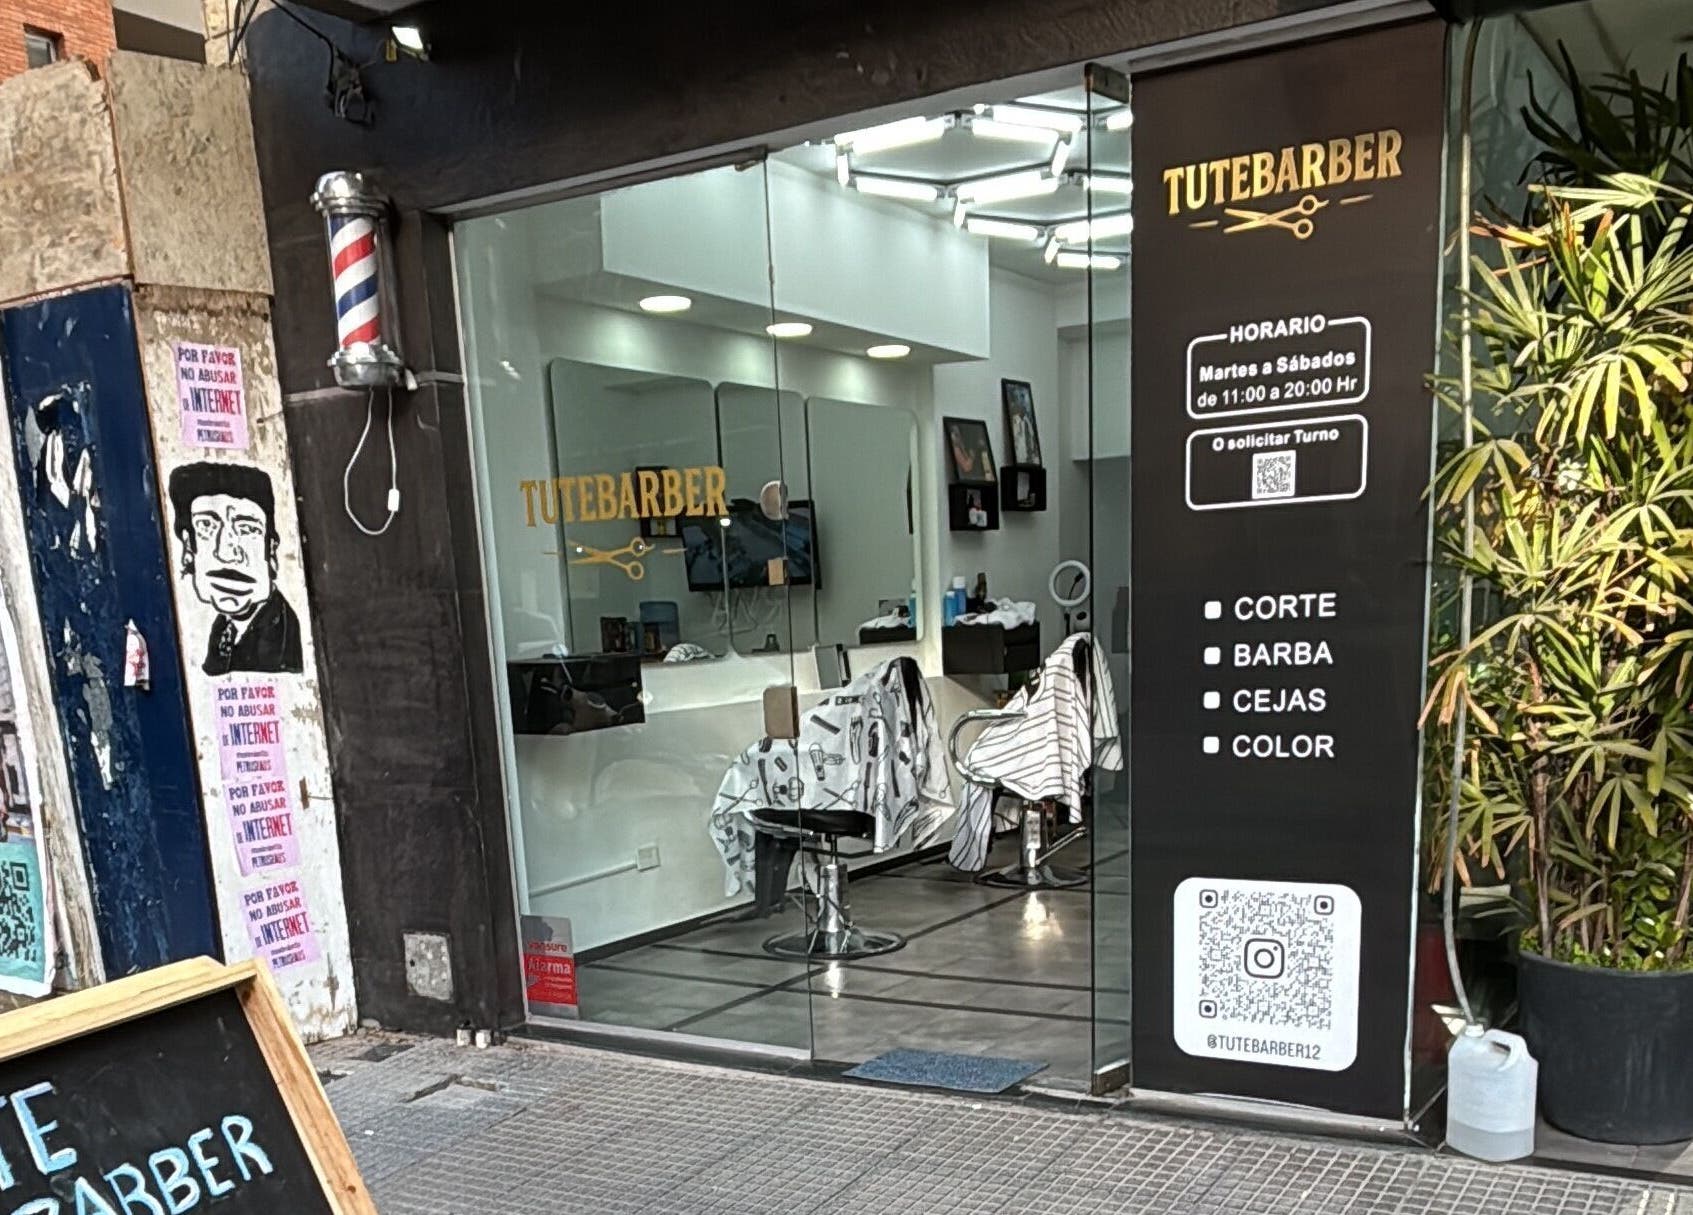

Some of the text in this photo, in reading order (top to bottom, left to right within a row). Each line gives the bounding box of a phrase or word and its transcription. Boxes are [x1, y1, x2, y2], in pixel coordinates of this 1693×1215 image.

[1163, 129, 1402, 216] TUTEBARBER
[1230, 314, 1326, 343] HORARIO
[178, 347, 236, 366] POR FAVOR
[1199, 351, 1356, 382] Martes a Sábados
[181, 368, 236, 384] NO ABUSAR
[190, 387, 241, 415] INTERNET
[1198, 376, 1358, 408] de 11:00 a 20:00 Hr
[1212, 428, 1339, 450] O solicitar Turno
[520, 466, 729, 527] TUTEBARBER
[1234, 592, 1336, 620] CORTE
[1234, 641, 1334, 666] BARBA
[218, 686, 275, 700] POR FAVOR
[1233, 688, 1326, 712] CEJAS
[220, 704, 275, 717] NO ABUSAR
[229, 721, 280, 746] INTERNET
[1232, 734, 1334, 758] COLOR
[229, 780, 285, 800] POR FAVOR
[232, 797, 286, 816] NO ABUSAR
[242, 813, 292, 842] INTERNET
[244, 880, 299, 906] POR FAVOR
[248, 896, 302, 922] NO ABUSAR
[260, 912, 310, 945] INTERNET
[1207, 1034, 1321, 1060] @TUTEBARBER12
[10, 1115, 273, 1215] ARBER
